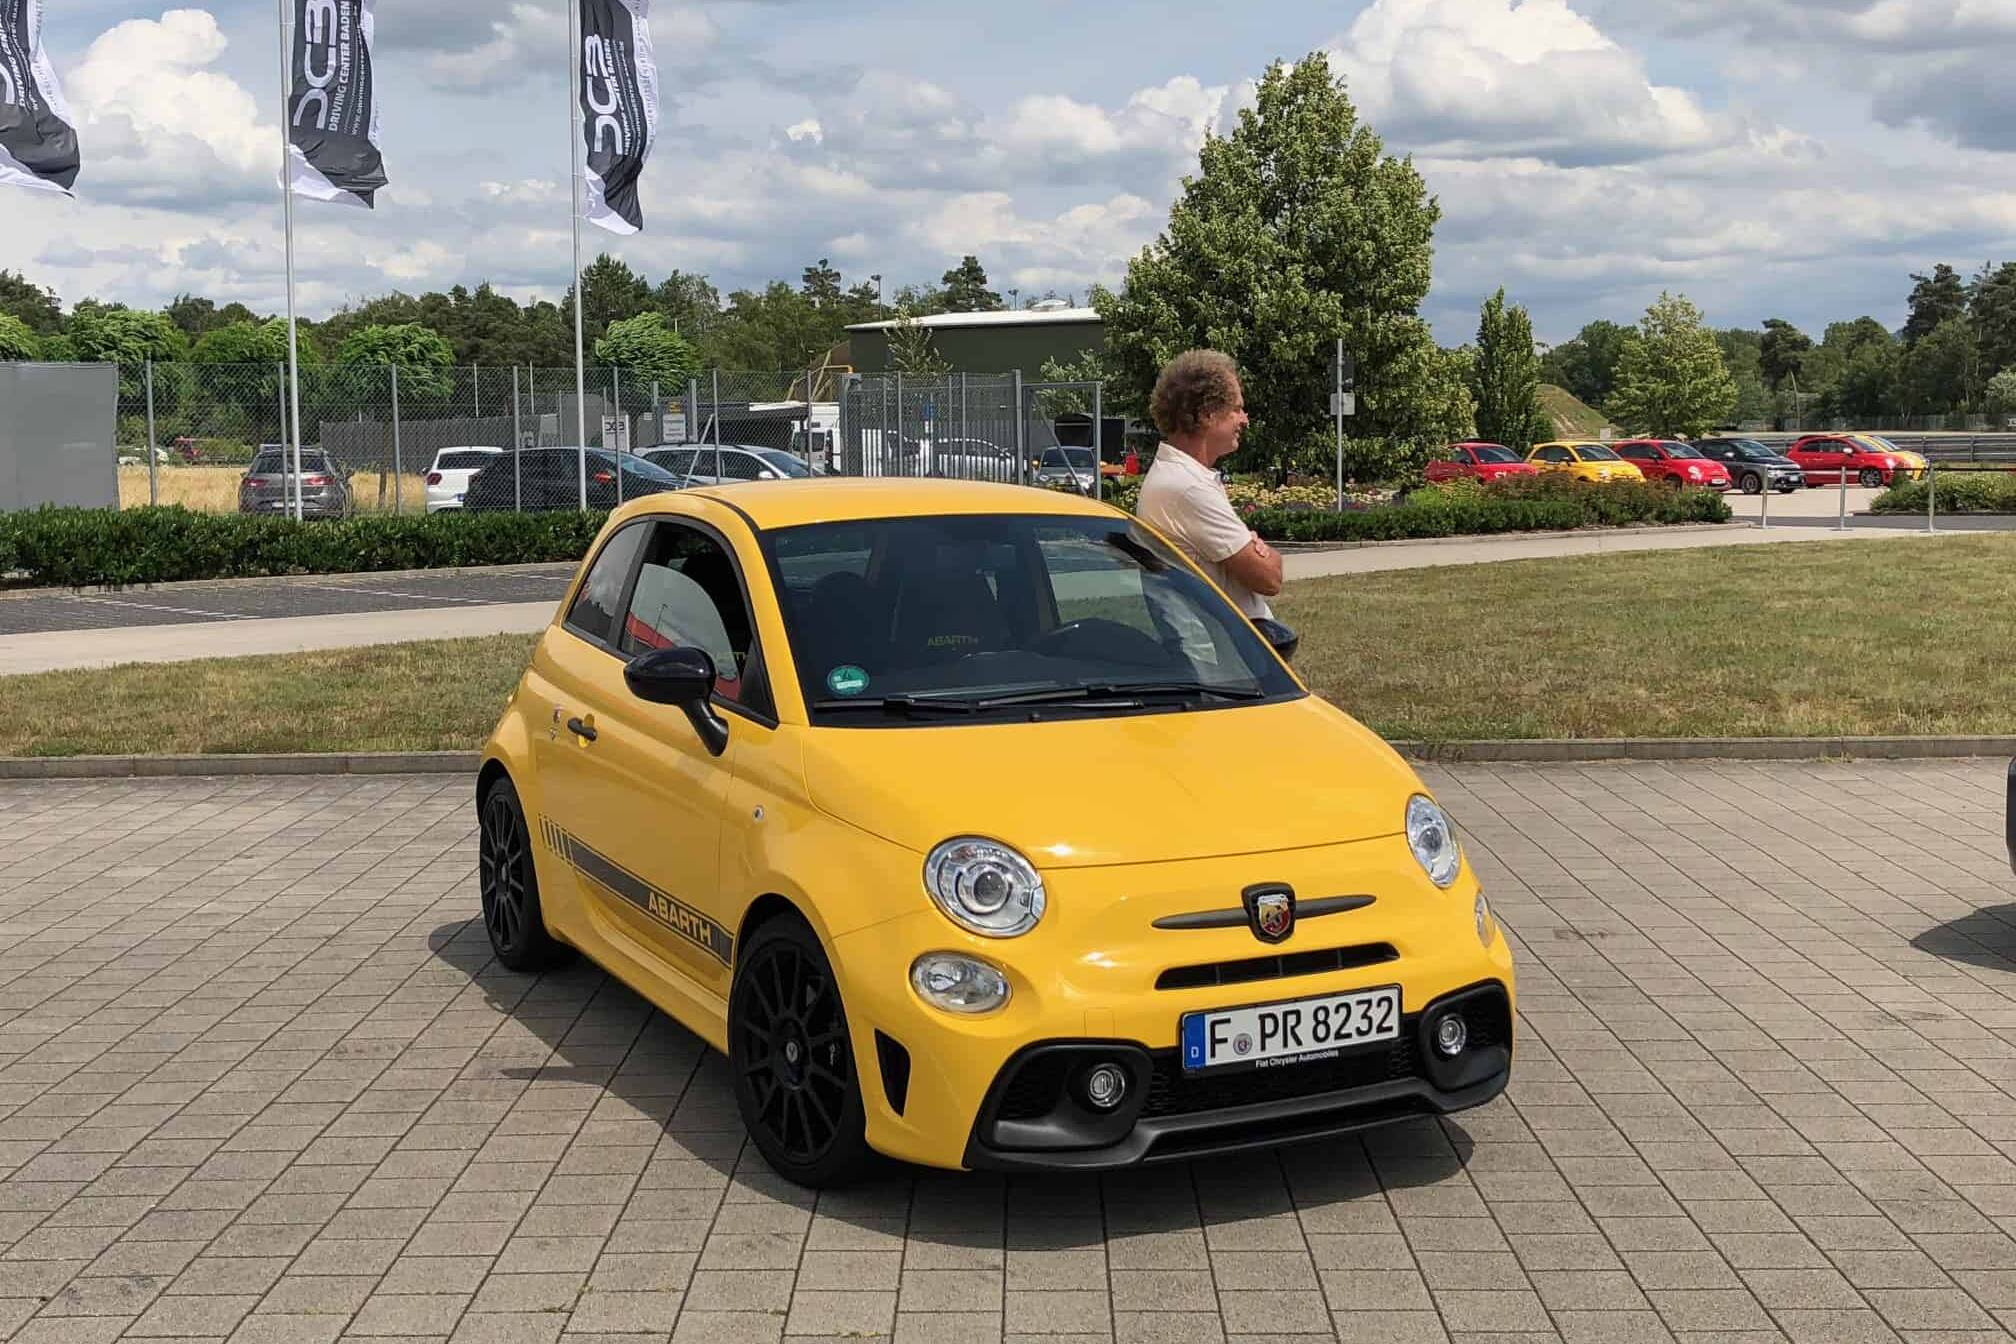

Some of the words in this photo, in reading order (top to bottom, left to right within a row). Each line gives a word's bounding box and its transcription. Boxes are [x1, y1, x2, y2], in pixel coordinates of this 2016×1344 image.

[0, 14, 11, 55] CENT
[340, 0, 350, 41] BADEN
[7, 56, 25, 107] DRIVING
[340, 42, 350, 84] CENTER
[328, 84, 347, 132] DRIVING
[648, 891, 712, 946] ABARTH
[1191, 1046, 1199, 1058] D
[1210, 1018, 1231, 1058] F
[1258, 1009, 1303, 1051] PR
[1312, 996, 1394, 1043] 8232
[1256, 1059, 1268, 1068] Fiat
[1269, 1055, 1297, 1067] Chrysler
[1299, 1050, 1339, 1062] Automobiles
